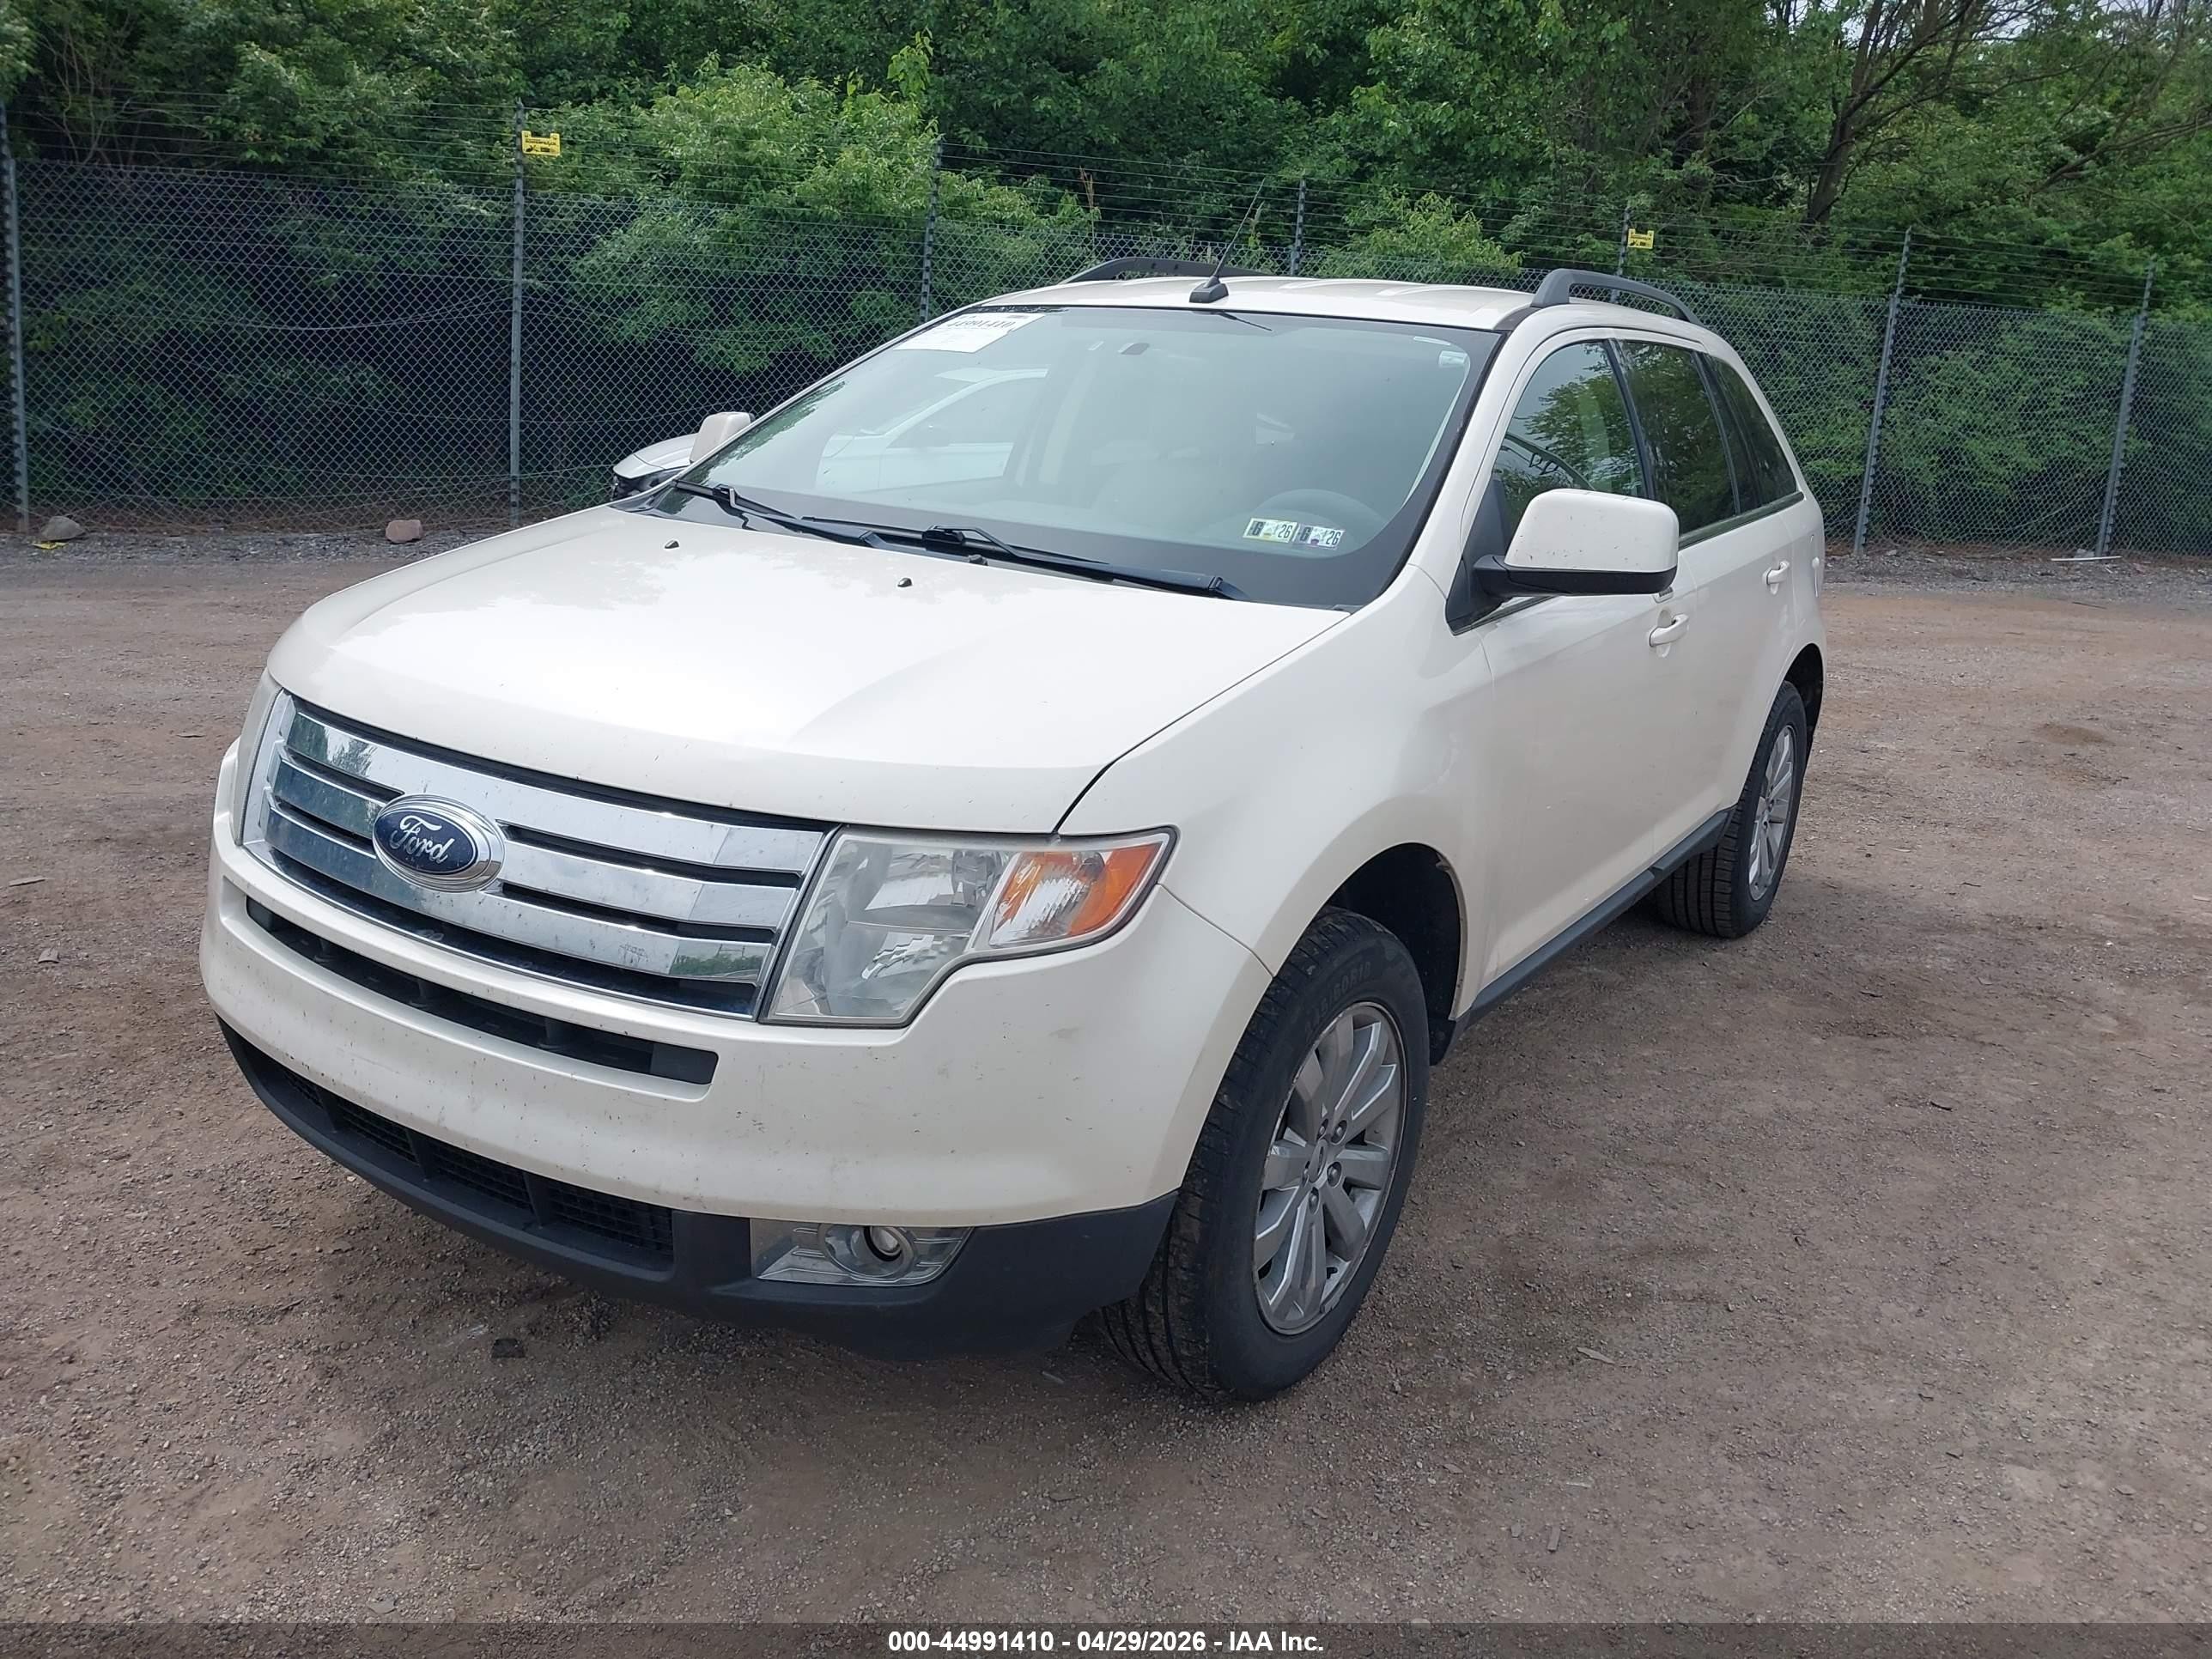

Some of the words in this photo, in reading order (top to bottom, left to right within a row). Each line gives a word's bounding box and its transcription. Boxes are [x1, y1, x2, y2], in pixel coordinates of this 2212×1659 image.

[1277, 524, 1292, 538] 26
[1325, 530, 1341, 545] 26
[389, 815, 455, 864] Ford
